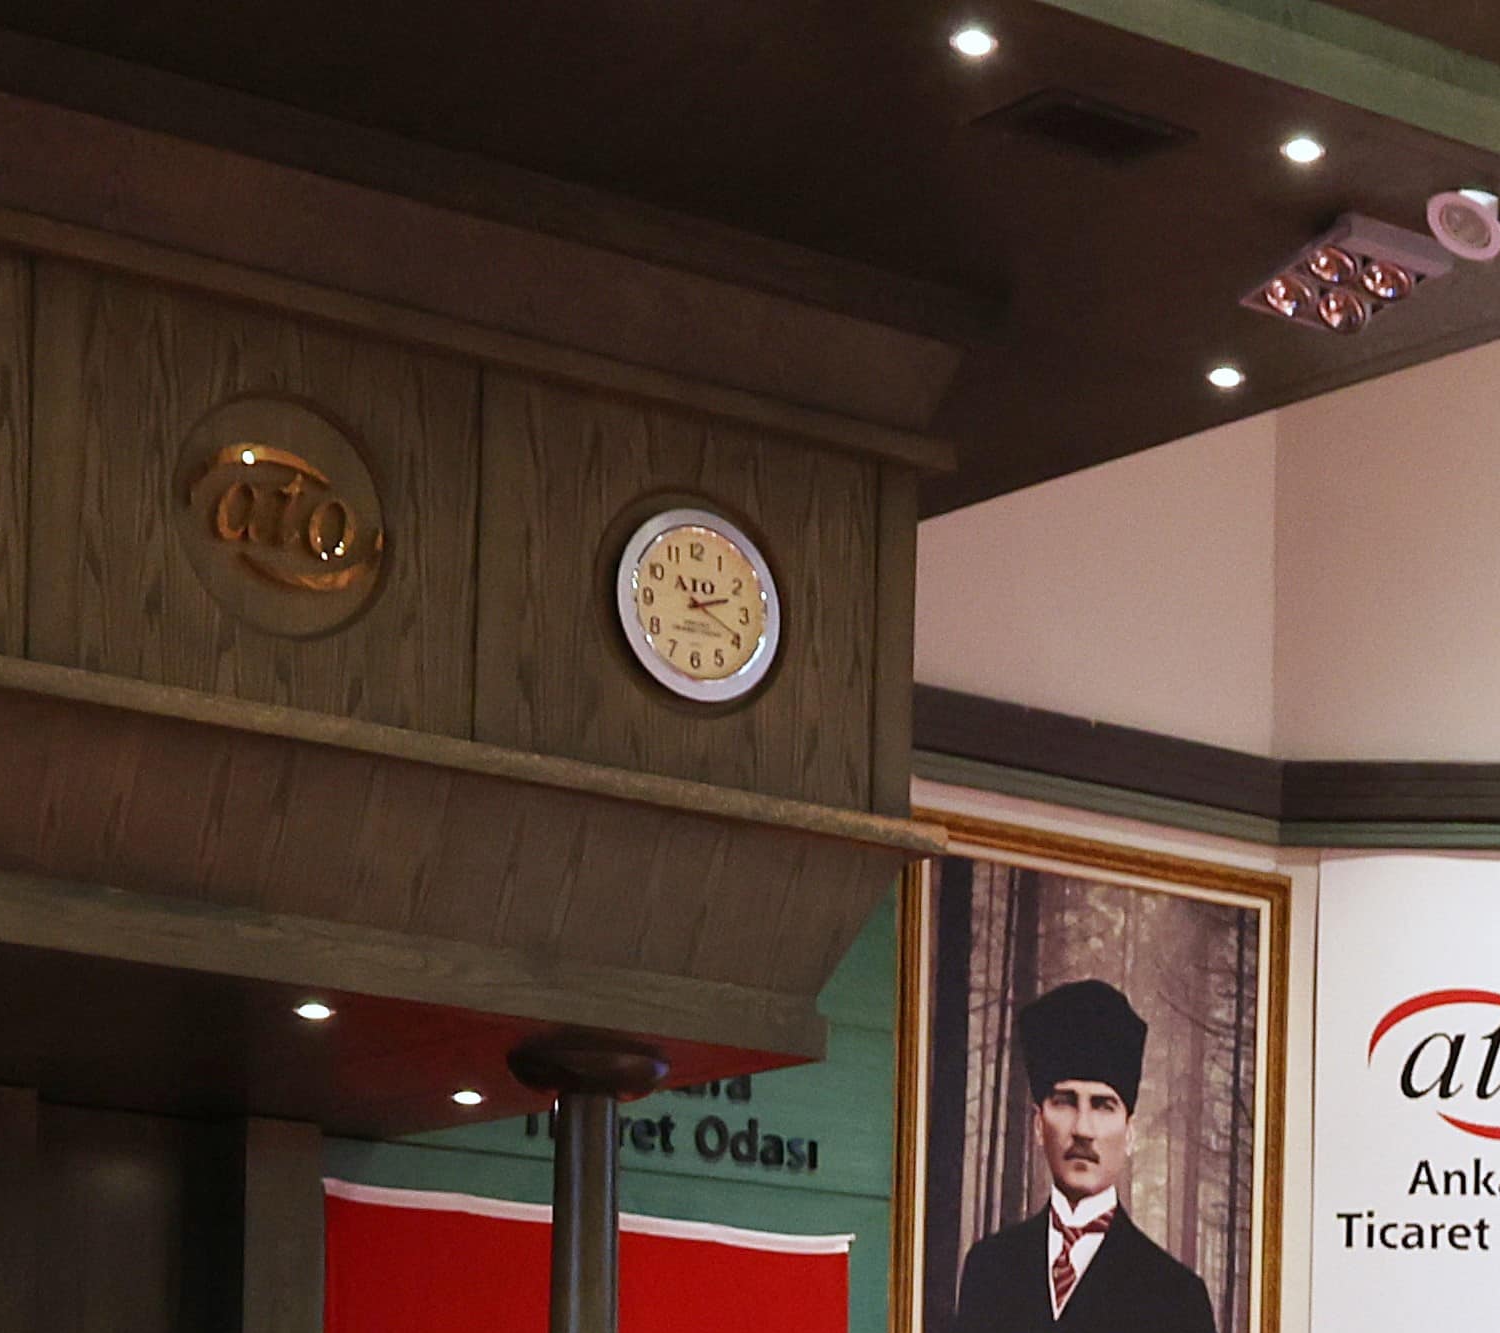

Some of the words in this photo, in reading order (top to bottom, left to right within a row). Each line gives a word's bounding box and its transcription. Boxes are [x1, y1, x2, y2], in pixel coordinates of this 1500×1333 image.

[667, 544, 680, 564] 11
[690, 542, 705, 562] 12
[650, 563, 664, 580] 10
[716, 554, 723, 572] 1
[731, 577, 743, 595] 2
[642, 587, 654, 606] 9
[650, 616, 660, 635] 8
[739, 607, 749, 626] 3
[667, 638, 678, 657] 7
[731, 632, 741, 650] 4
[690, 651, 700, 669] 6
[714, 649, 724, 667] 5
[694, 1114, 819, 1171] Odası
[1336, 1210, 1490, 1251] Ticaret
